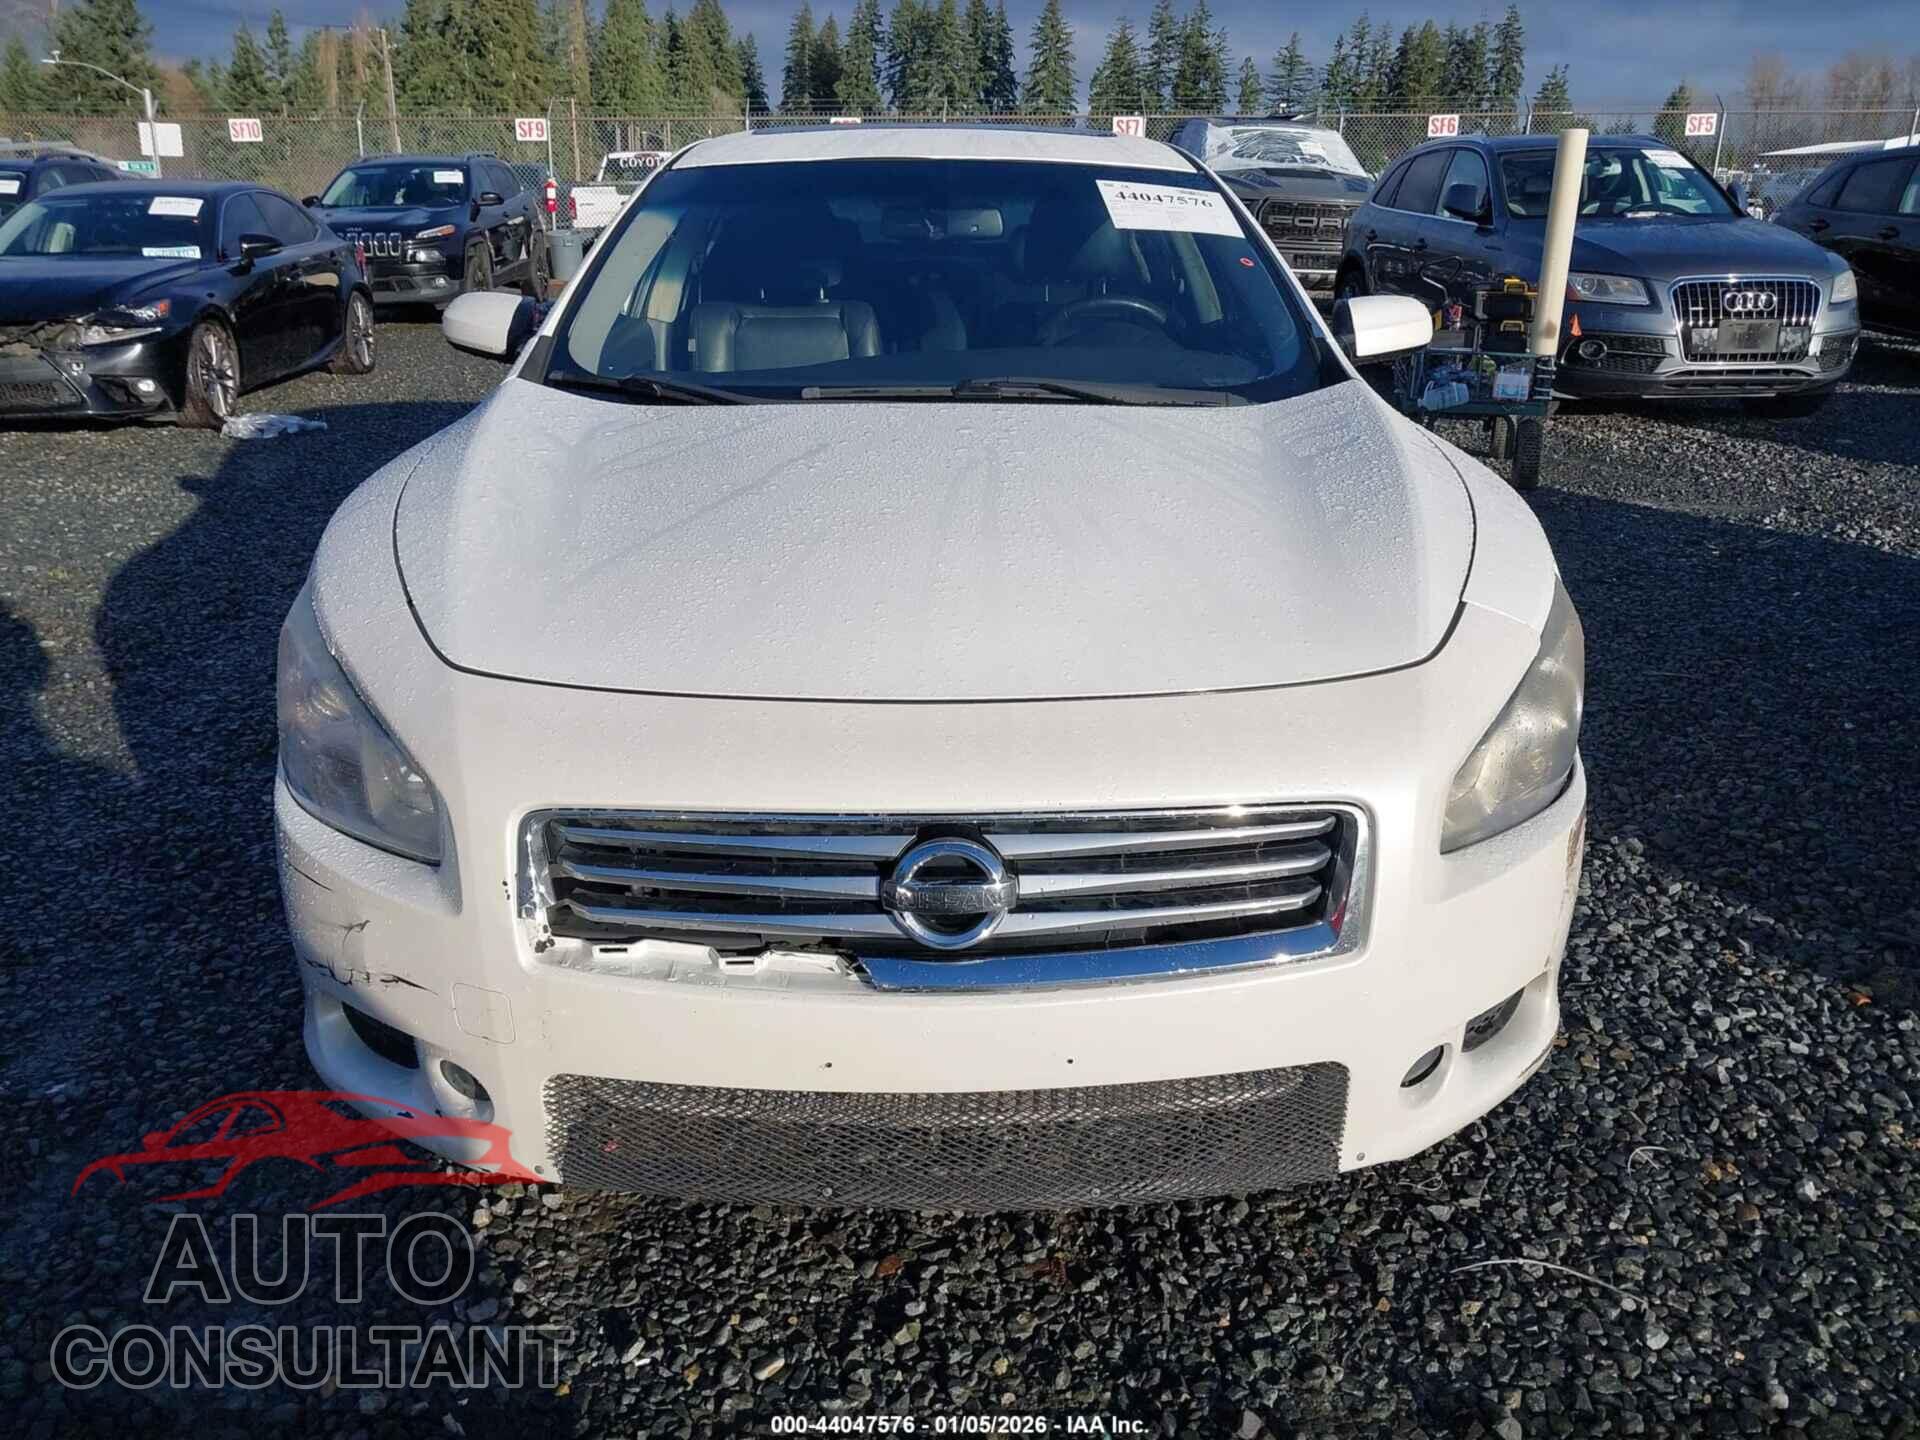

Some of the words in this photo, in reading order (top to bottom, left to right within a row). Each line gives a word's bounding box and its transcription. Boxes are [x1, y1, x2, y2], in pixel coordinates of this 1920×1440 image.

[230, 121, 261, 139] SF10
[518, 121, 545, 138] SF9
[1116, 119, 1140, 135] SF7
[1430, 116, 1457, 134] SF6
[1688, 115, 1714, 133] SF5
[1115, 191, 1214, 208] 44047576
[1268, 215, 1349, 228] FOR
